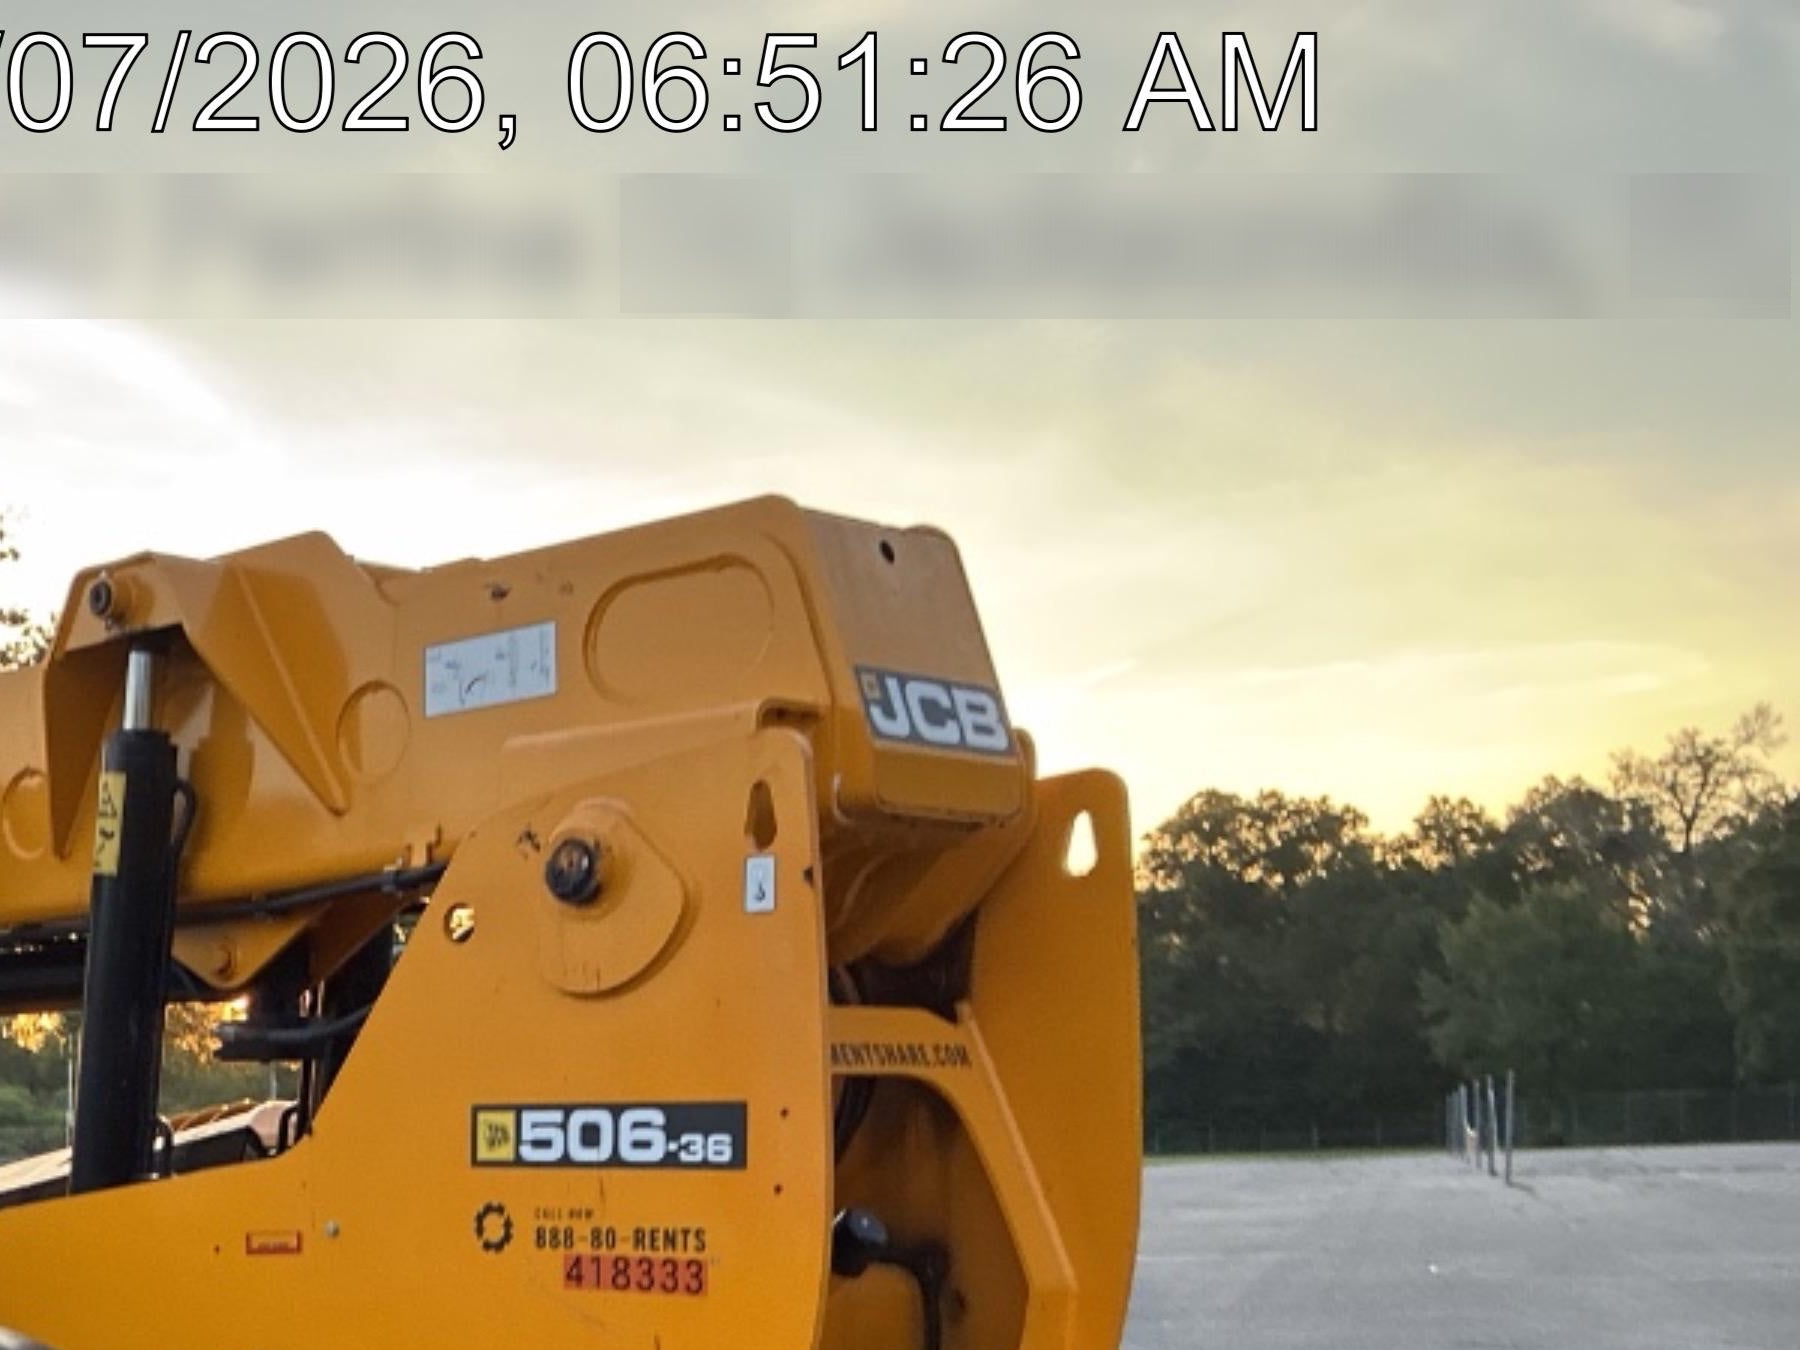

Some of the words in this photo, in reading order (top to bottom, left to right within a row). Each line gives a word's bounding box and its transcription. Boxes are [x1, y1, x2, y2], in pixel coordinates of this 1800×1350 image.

[869, 676, 1009, 750] JCB
[534, 1226, 708, 1253] 888-80-RENTS
[565, 1255, 705, 1295] 418333
